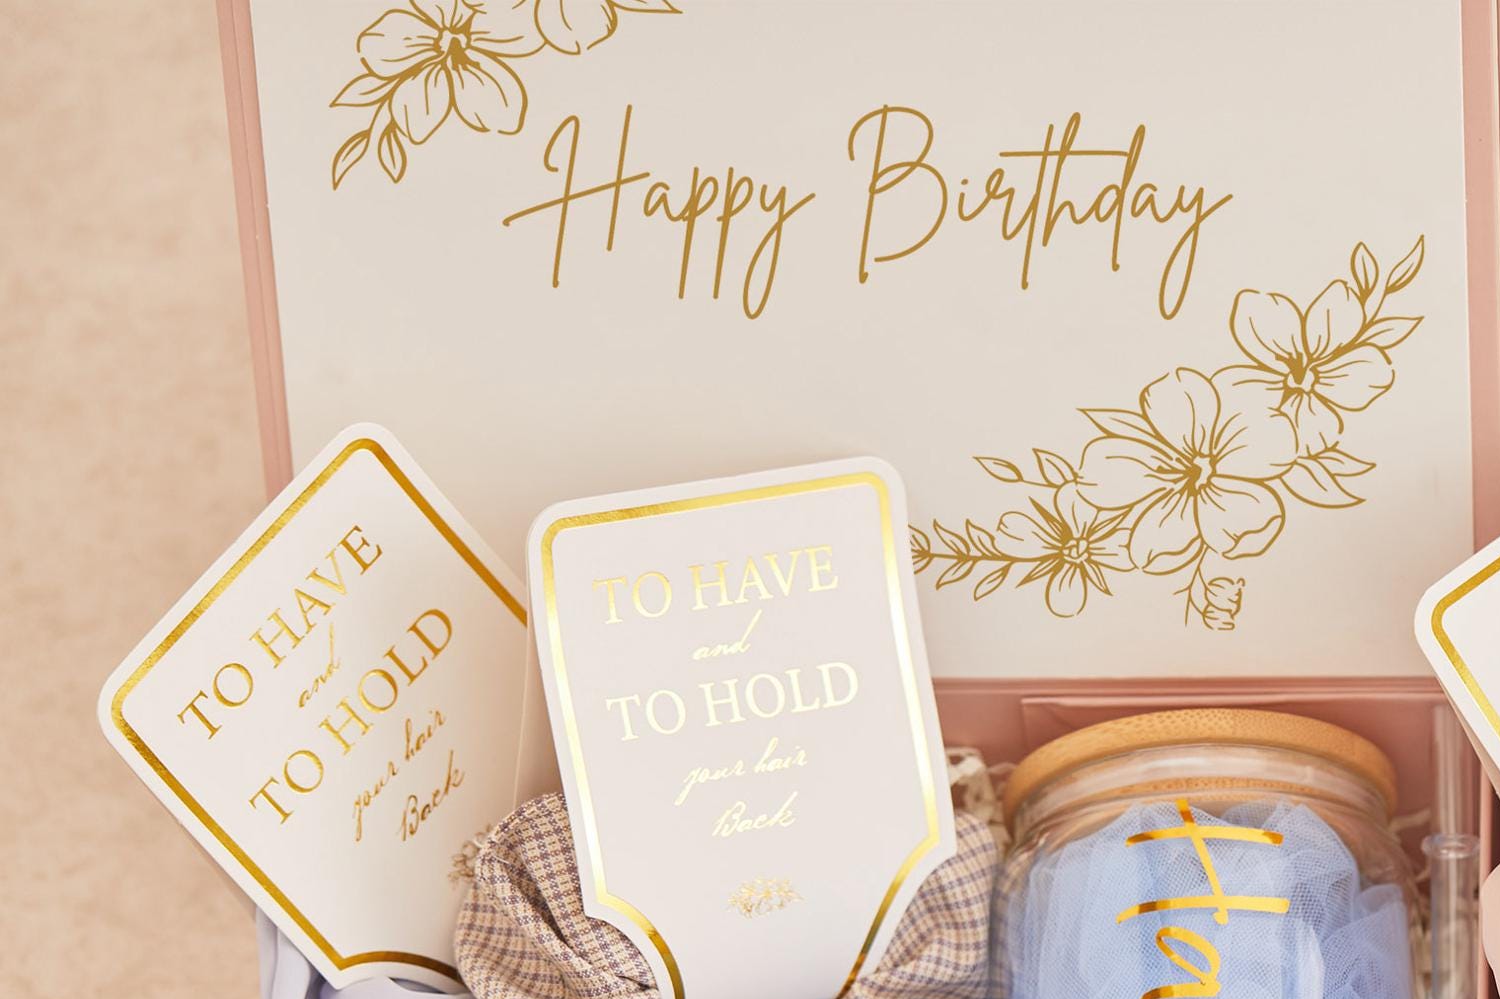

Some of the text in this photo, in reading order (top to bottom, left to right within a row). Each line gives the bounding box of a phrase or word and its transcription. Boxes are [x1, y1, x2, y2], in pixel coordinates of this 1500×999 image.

[503, 103, 1233, 321] Happy Birthday
[591, 544, 839, 625] TO HAVE
[176, 525, 384, 740] TO HAVE
[298, 621, 341, 708] and
[691, 608, 763, 661] and
[248, 608, 453, 825] TO HOLD
[605, 661, 860, 742] TO HOLD
[352, 709, 447, 842] your hair
[397, 750, 465, 842] Back
[673, 736, 809, 807] your hair
[711, 790, 799, 837] Back
